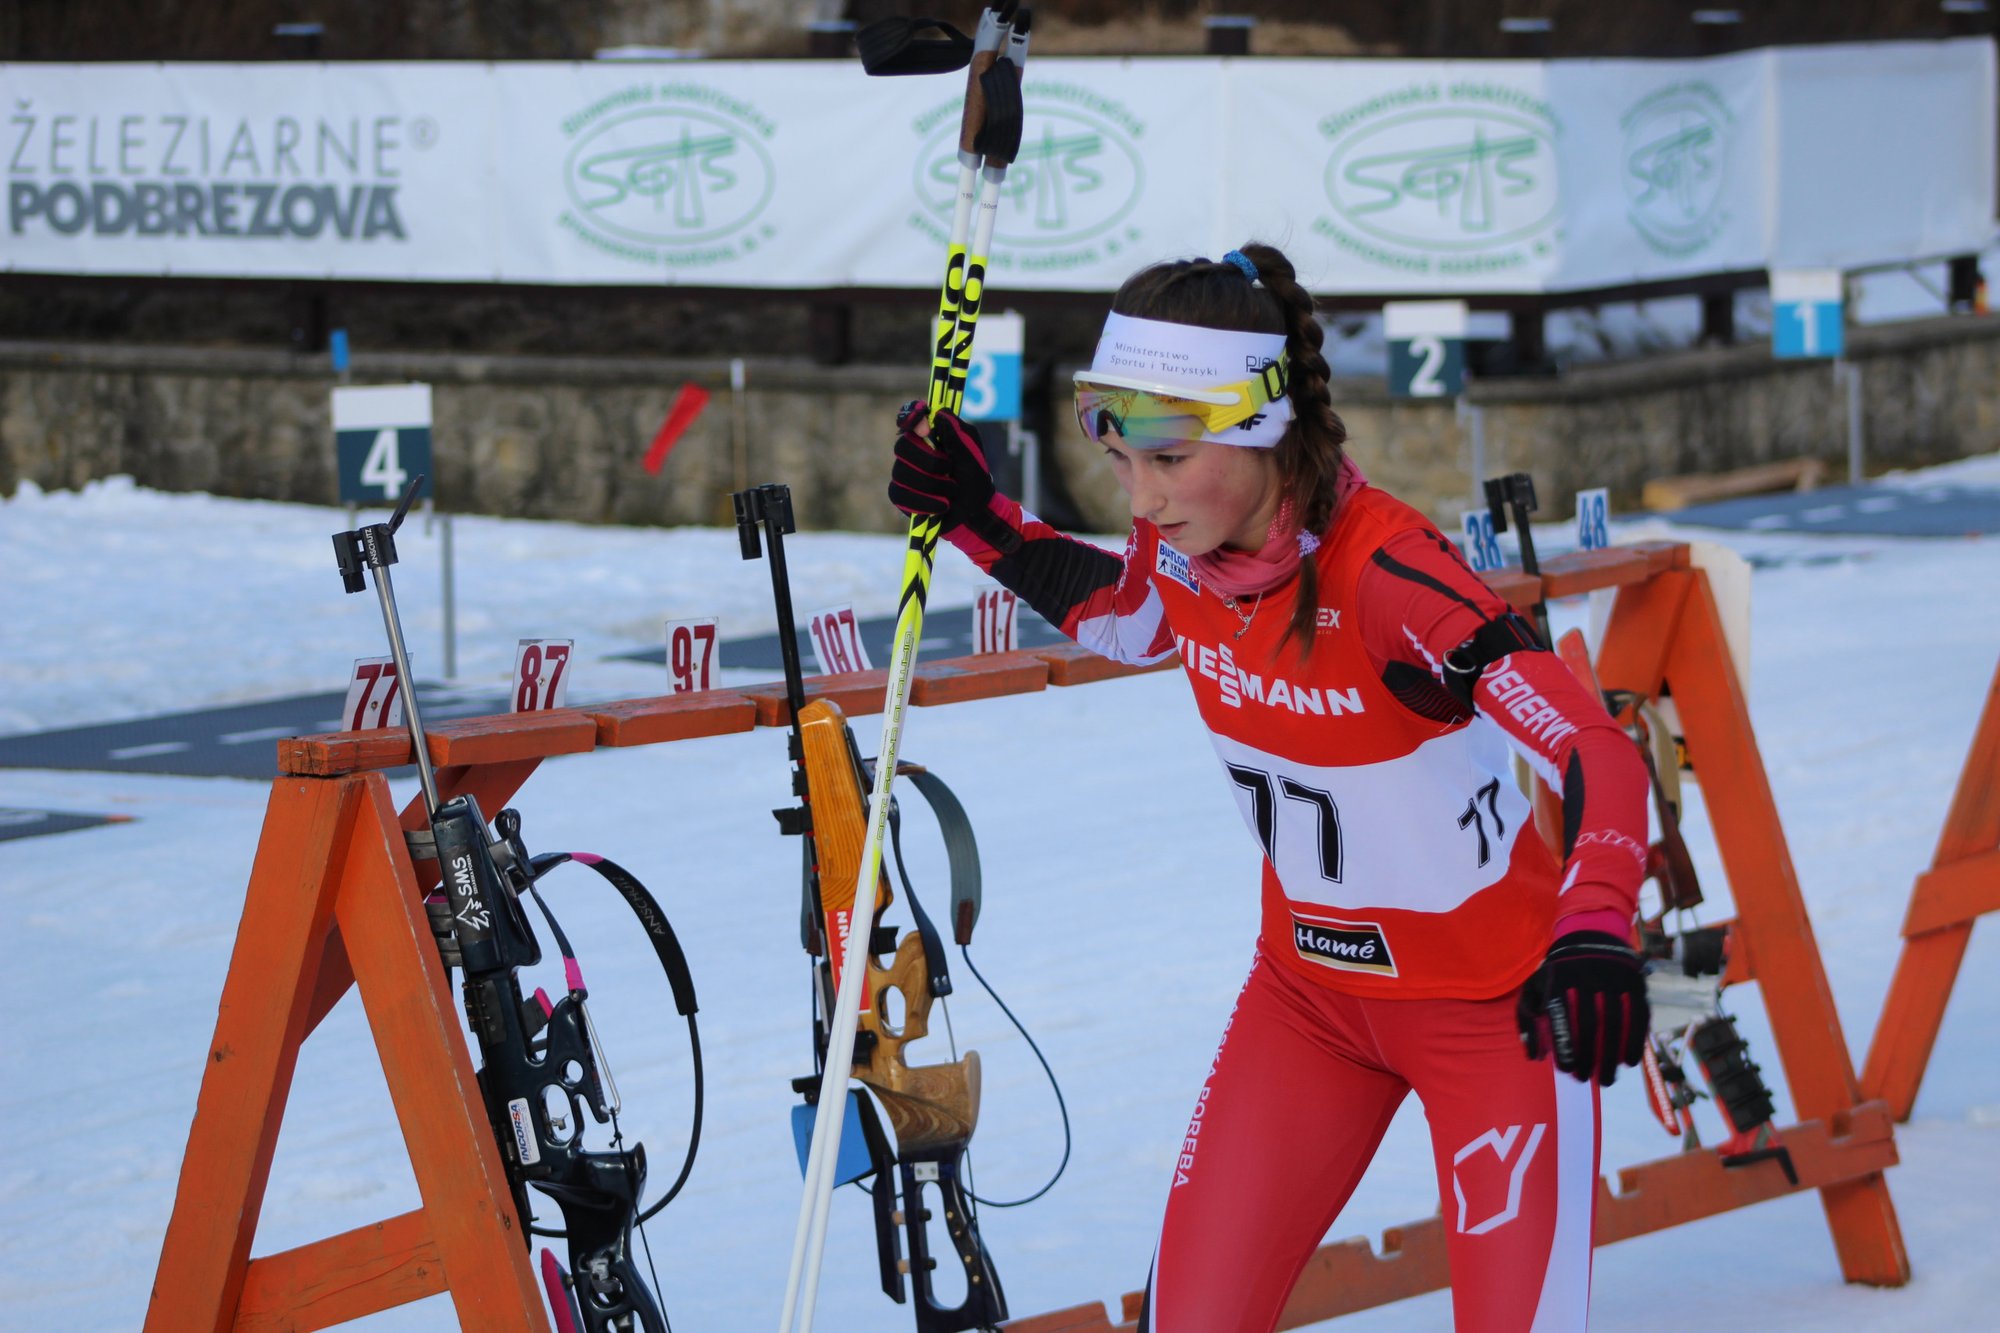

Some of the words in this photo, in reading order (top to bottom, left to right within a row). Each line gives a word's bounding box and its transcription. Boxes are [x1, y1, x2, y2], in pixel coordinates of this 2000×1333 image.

[8, 99, 402, 176] ŽELEZIARNE
[1114, 342, 1189, 361] Ministerstwo
[1792, 306, 1819, 354] 1
[962, 352, 998, 419] 3
[1110, 355, 1145, 369] Sportu
[1150, 361, 1154, 369] i
[1160, 362, 1218, 376] Turystyki
[1408, 336, 1447, 397] 2
[360, 428, 408, 500] 4
[1466, 513, 1504, 571] 38
[1580, 495, 1607, 550] 48
[811, 608, 864, 673] 107
[977, 590, 1015, 654] 117
[516, 644, 570, 713] 87
[672, 624, 716, 695] 97
[1177, 634, 1366, 716] VIESSMANN
[351, 662, 401, 731] 77
[1486, 670, 1579, 755] ENERVI
[1225, 758, 1343, 884] 77
[452, 856, 473, 897] SMS
[1296, 927, 1376, 960] Hamé
[510, 1104, 529, 1161] INCORSA
